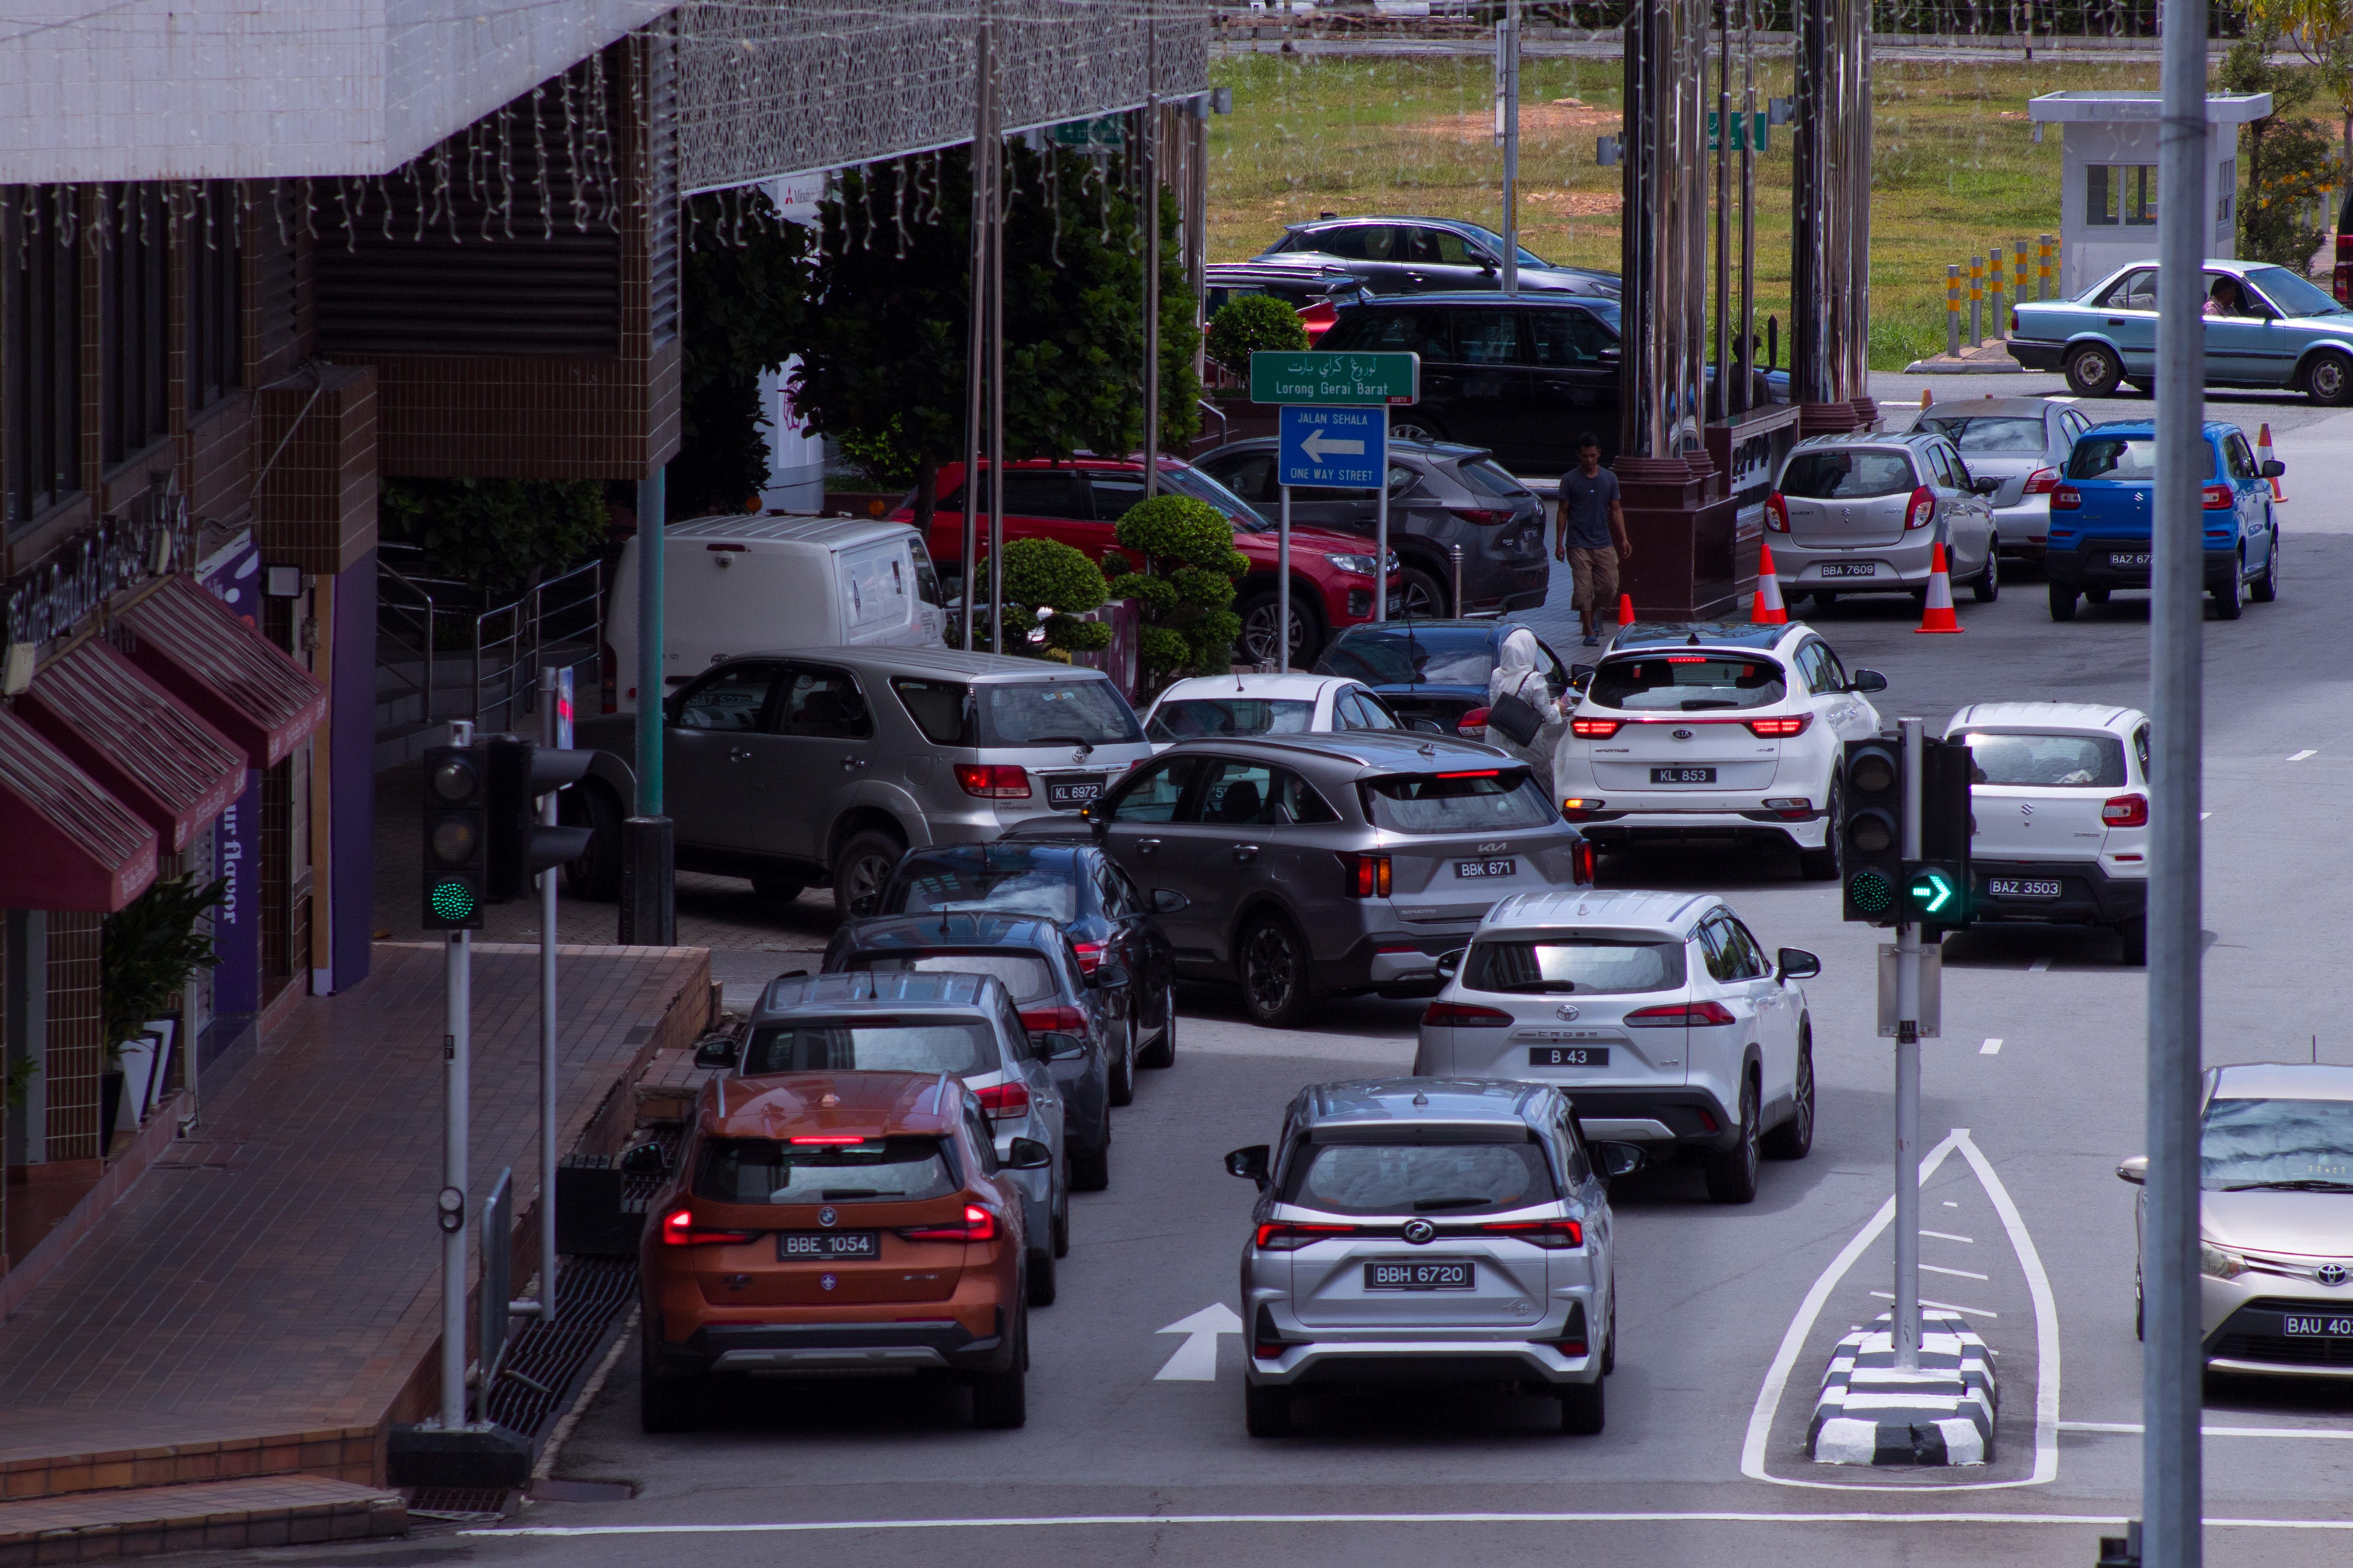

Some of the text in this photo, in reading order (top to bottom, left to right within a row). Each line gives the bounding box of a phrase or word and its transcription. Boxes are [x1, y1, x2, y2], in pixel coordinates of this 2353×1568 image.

[1288, 357, 1313, 375] بارت
[1276, 381, 1388, 397] Lorong Gerai Barat
[1298, 412, 1367, 425] JALAN SEHALA
[1290, 468, 1373, 481] ONE WAY STREET
[2112, 555, 2133, 564] BAZ
[1823, 565, 1873, 575] BBA 7609
[1660, 770, 1706, 781] KL 853
[1056, 786, 1098, 799] KL 6972
[1478, 842, 1507, 852] KIA
[1461, 862, 1510, 876] BBK 671
[224, 840, 242, 924] flavor
[1992, 881, 2058, 894] BAZ 3503
[1551, 1050, 1587, 1063] B 43
[787, 1236, 869, 1253] BBE 1054
[1377, 1267, 1463, 1282] BBH 6720
[2288, 1318, 2353, 1334] BAU 40
